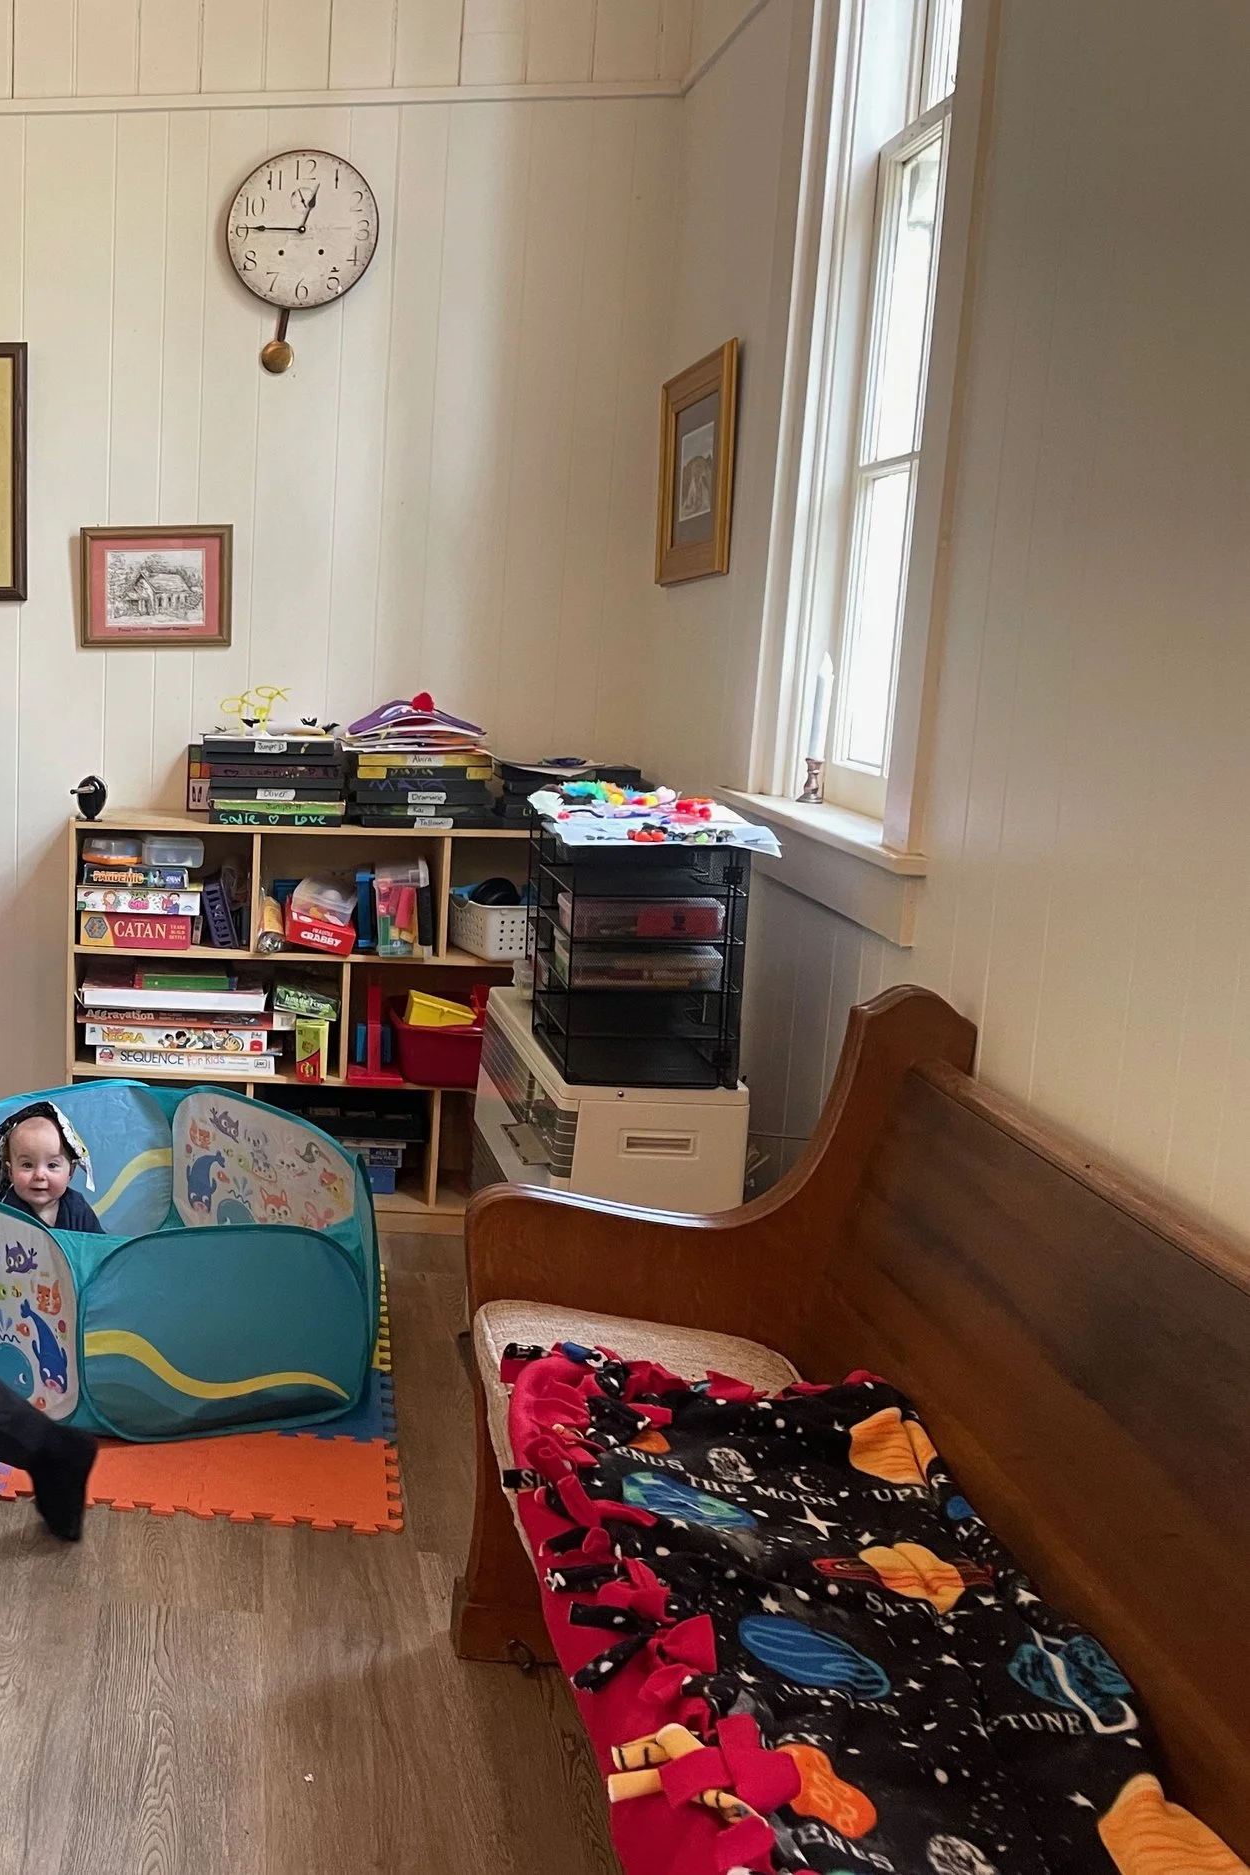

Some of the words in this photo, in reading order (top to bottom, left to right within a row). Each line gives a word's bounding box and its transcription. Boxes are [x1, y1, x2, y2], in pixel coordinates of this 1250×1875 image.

[269, 170, 282, 191] 11
[296, 159, 317, 181] 12
[244, 196, 266, 217] 10
[350, 190, 364, 213] 2
[236, 224, 249, 244] 9
[355, 219, 370, 241] 3
[243, 249, 258, 272] 8
[346, 245, 360, 267] 4
[266, 271, 280, 293] 7
[295, 278, 309, 301] 6
[264, 790, 287, 798] Oliver
[295, 814, 327, 825] Love
[92, 871, 144, 883] PANDEMIC
[114, 921, 167, 939] CATAN
[301, 931, 342, 947] CRABBY
[86, 1009, 155, 1021] Aggravation
[120, 1050, 184, 1065] SEQUENCE
[187, 1055, 204, 1066] for
[613, 1446, 685, 1471] ENUS
[686, 1472, 741, 1494] THE
[751, 1484, 839, 1508] MOON
